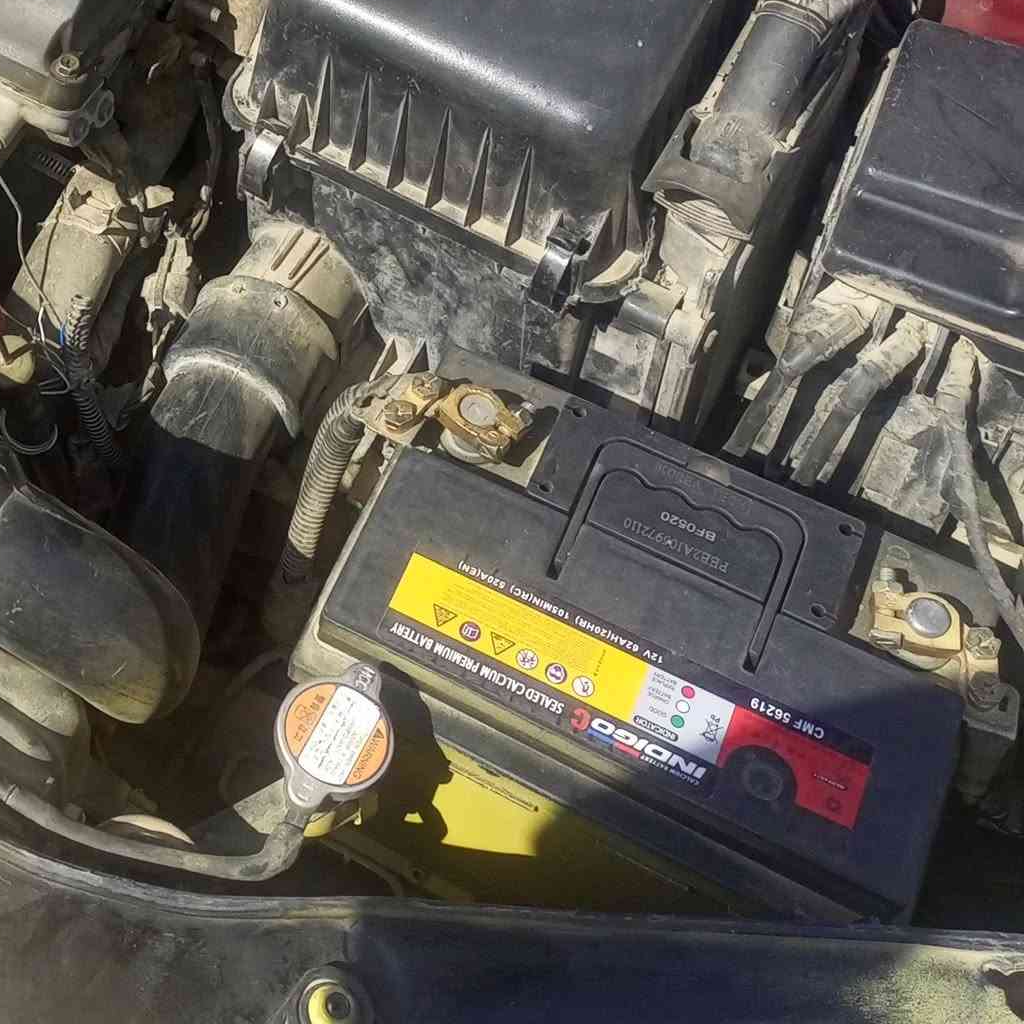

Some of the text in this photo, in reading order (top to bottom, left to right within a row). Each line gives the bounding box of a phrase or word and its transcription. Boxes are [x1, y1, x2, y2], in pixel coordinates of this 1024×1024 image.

[658, 510, 716, 542] BF0520
[455, 558, 506, 590] 520A(EN)
[507, 583, 571, 620] 105MIN(RC)
[572, 614, 640, 653] 62AH(20HR)
[388, 620, 565, 714] SEALED CALCIUM PREMIUM BATTERY
[641, 646, 665, 664] 12V
[634, 715, 677, 740] INDICATOR
[708, 712, 721, 723] Pb
[748, 695, 826, 740] CMF 56219
[588, 714, 707, 779] INDIGO
